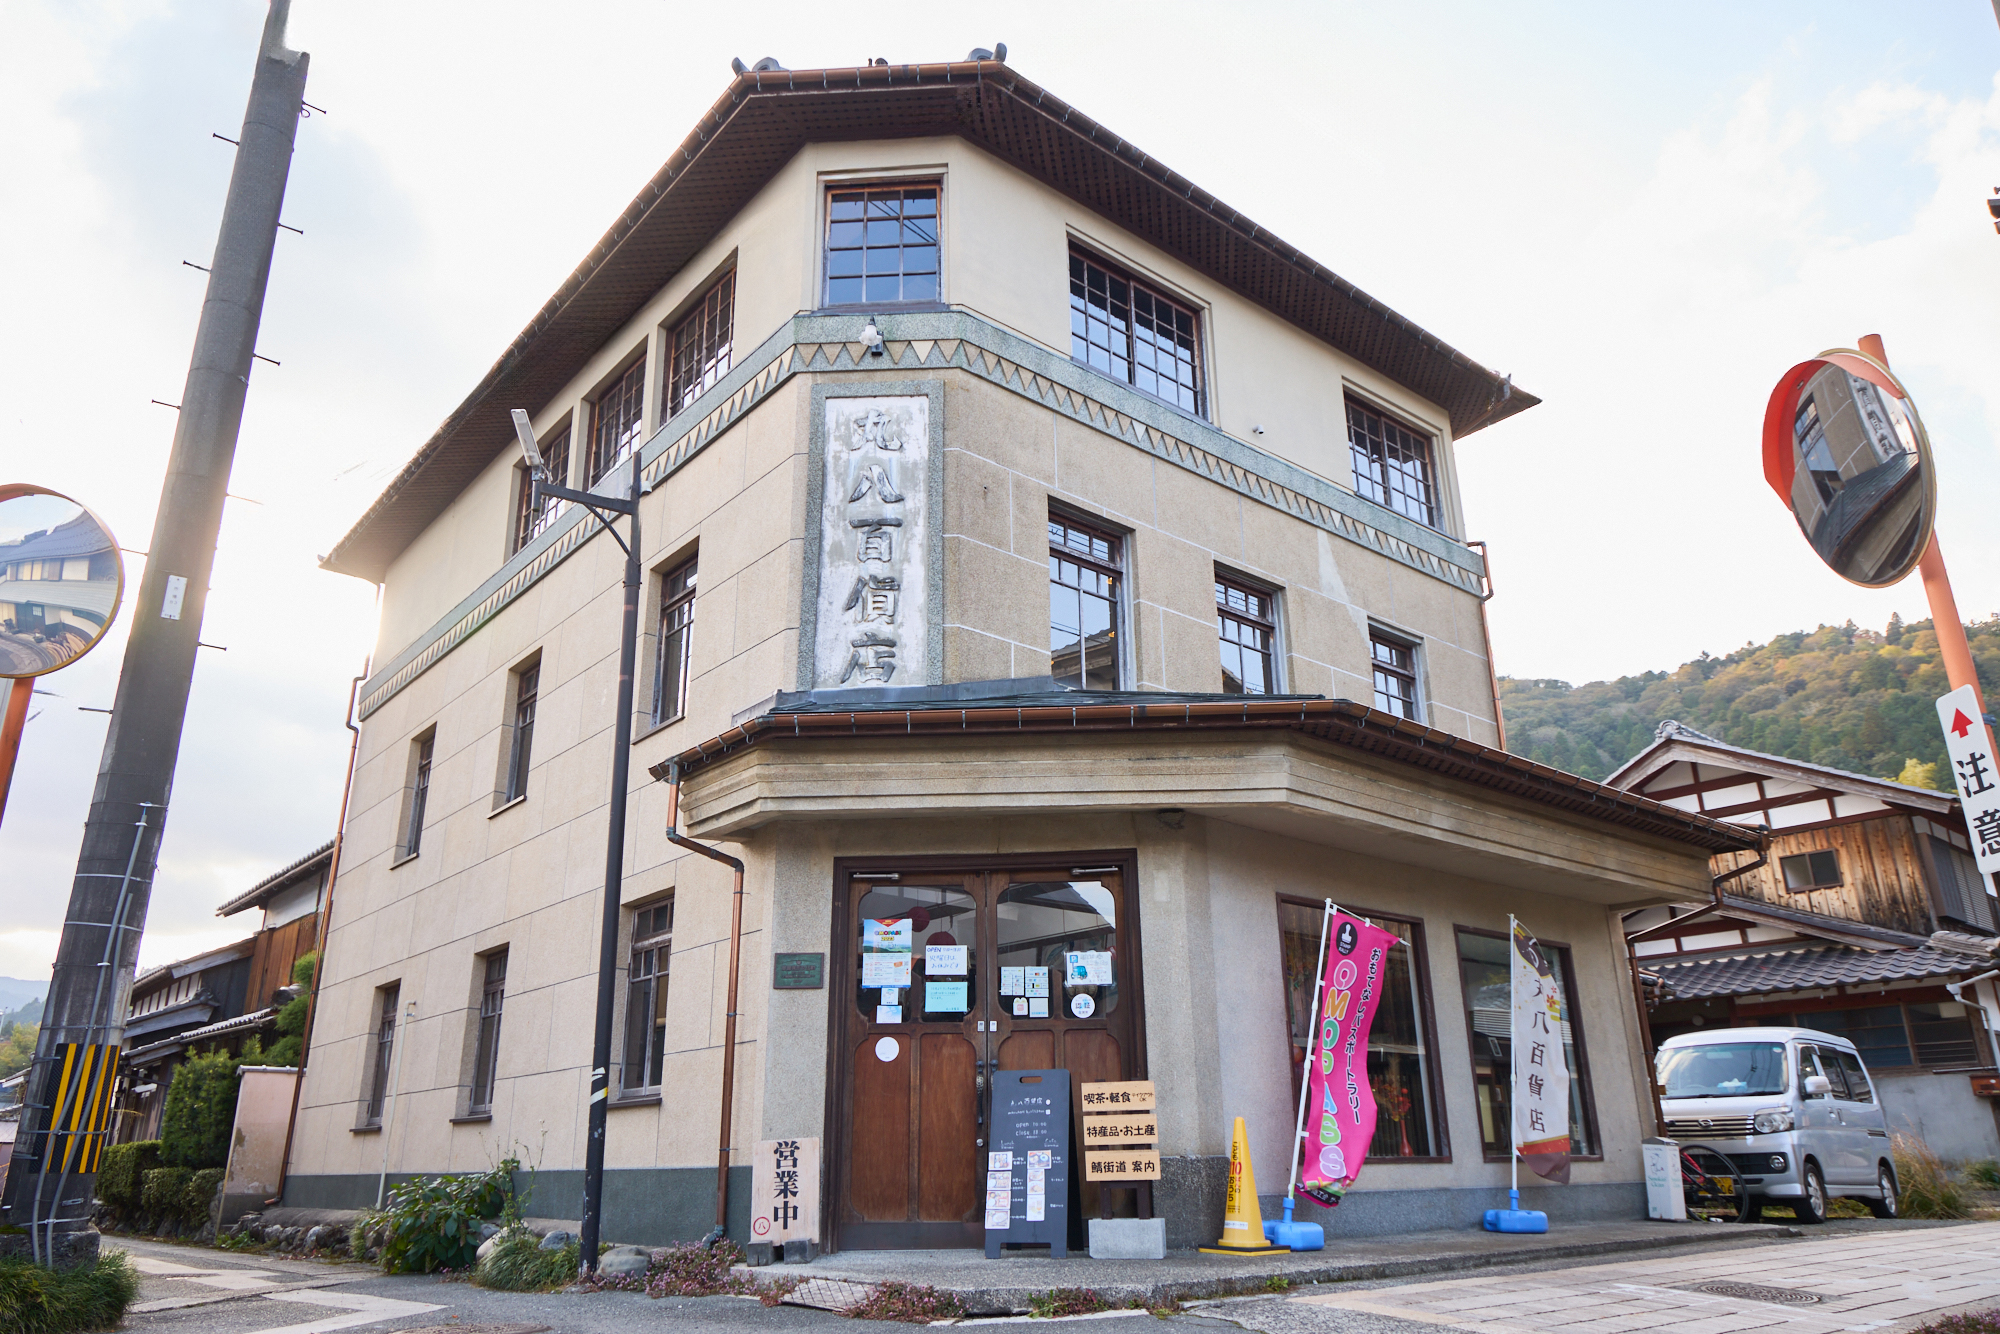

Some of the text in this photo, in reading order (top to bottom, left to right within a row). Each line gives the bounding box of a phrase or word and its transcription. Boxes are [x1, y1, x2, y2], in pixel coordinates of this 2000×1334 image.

[840, 408, 905, 684] 丸八百貨店
[1345, 946, 1382, 1125] おもてなしパスポートラリー
[1084, 1091, 1131, 1104] 喫茶・軽食
[1087, 1124, 1155, 1137] 特産品・お土産
[773, 1141, 800, 1230] 営業中
[1091, 1160, 1155, 1173] 鯖街道 案内
